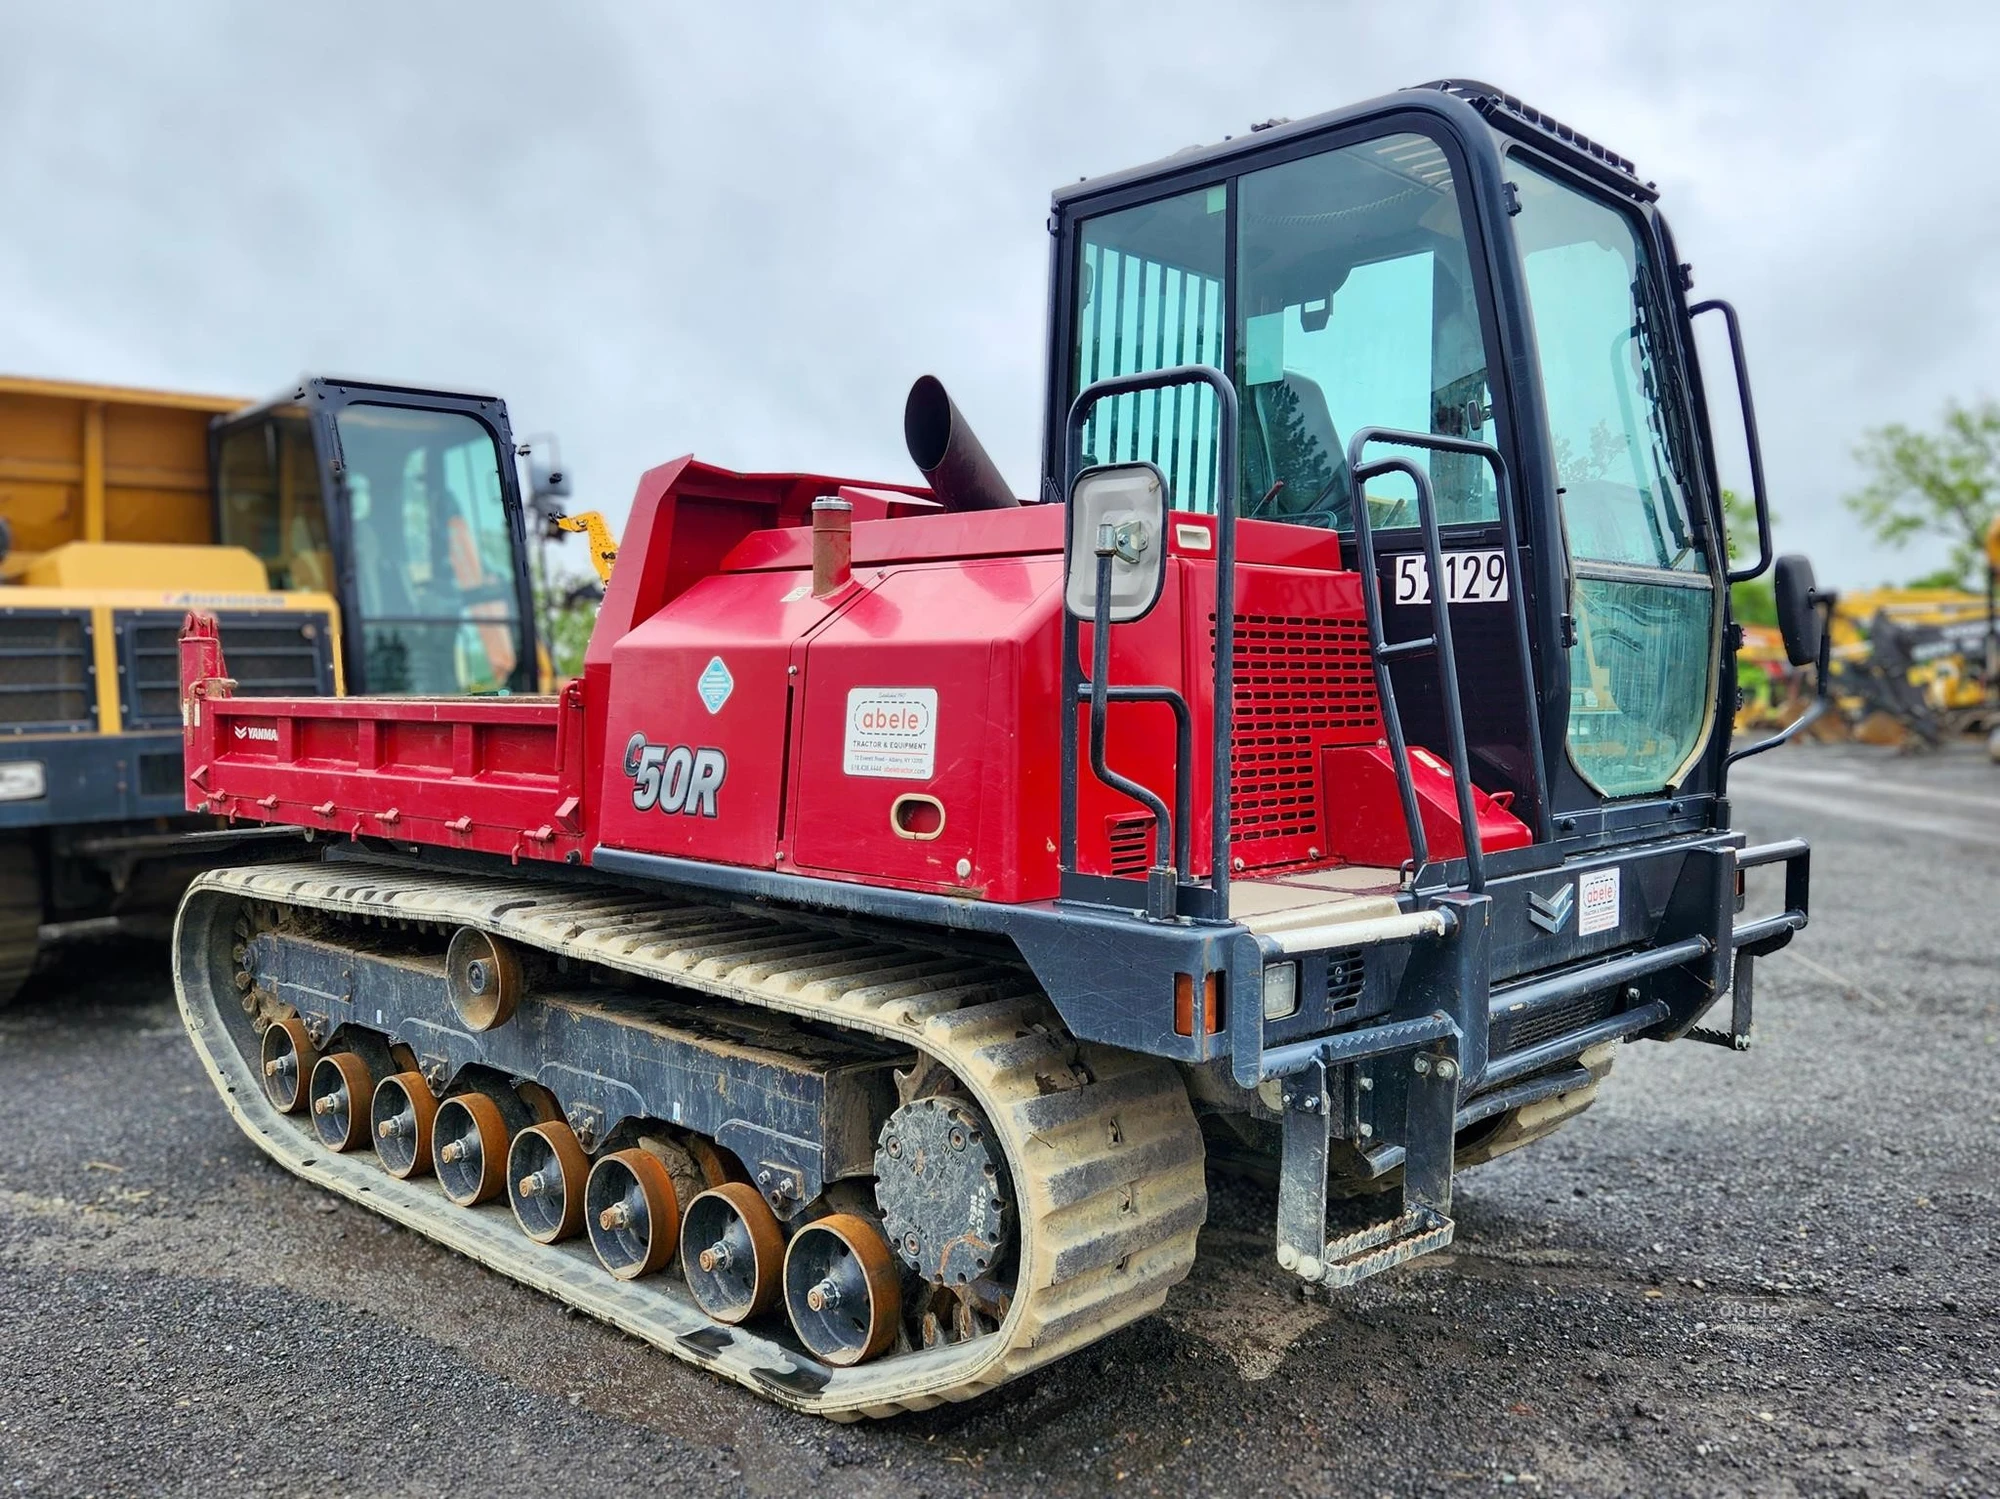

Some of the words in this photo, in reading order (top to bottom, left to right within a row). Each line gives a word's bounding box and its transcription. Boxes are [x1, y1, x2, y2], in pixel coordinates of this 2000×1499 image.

[863, 708, 918, 729] abele
[853, 740, 881, 748] TRACTOR
[890, 742, 927, 750] EQUIPMENT
[1587, 885, 1613, 903] abele
[976, 1186, 986, 1238] CHECK
